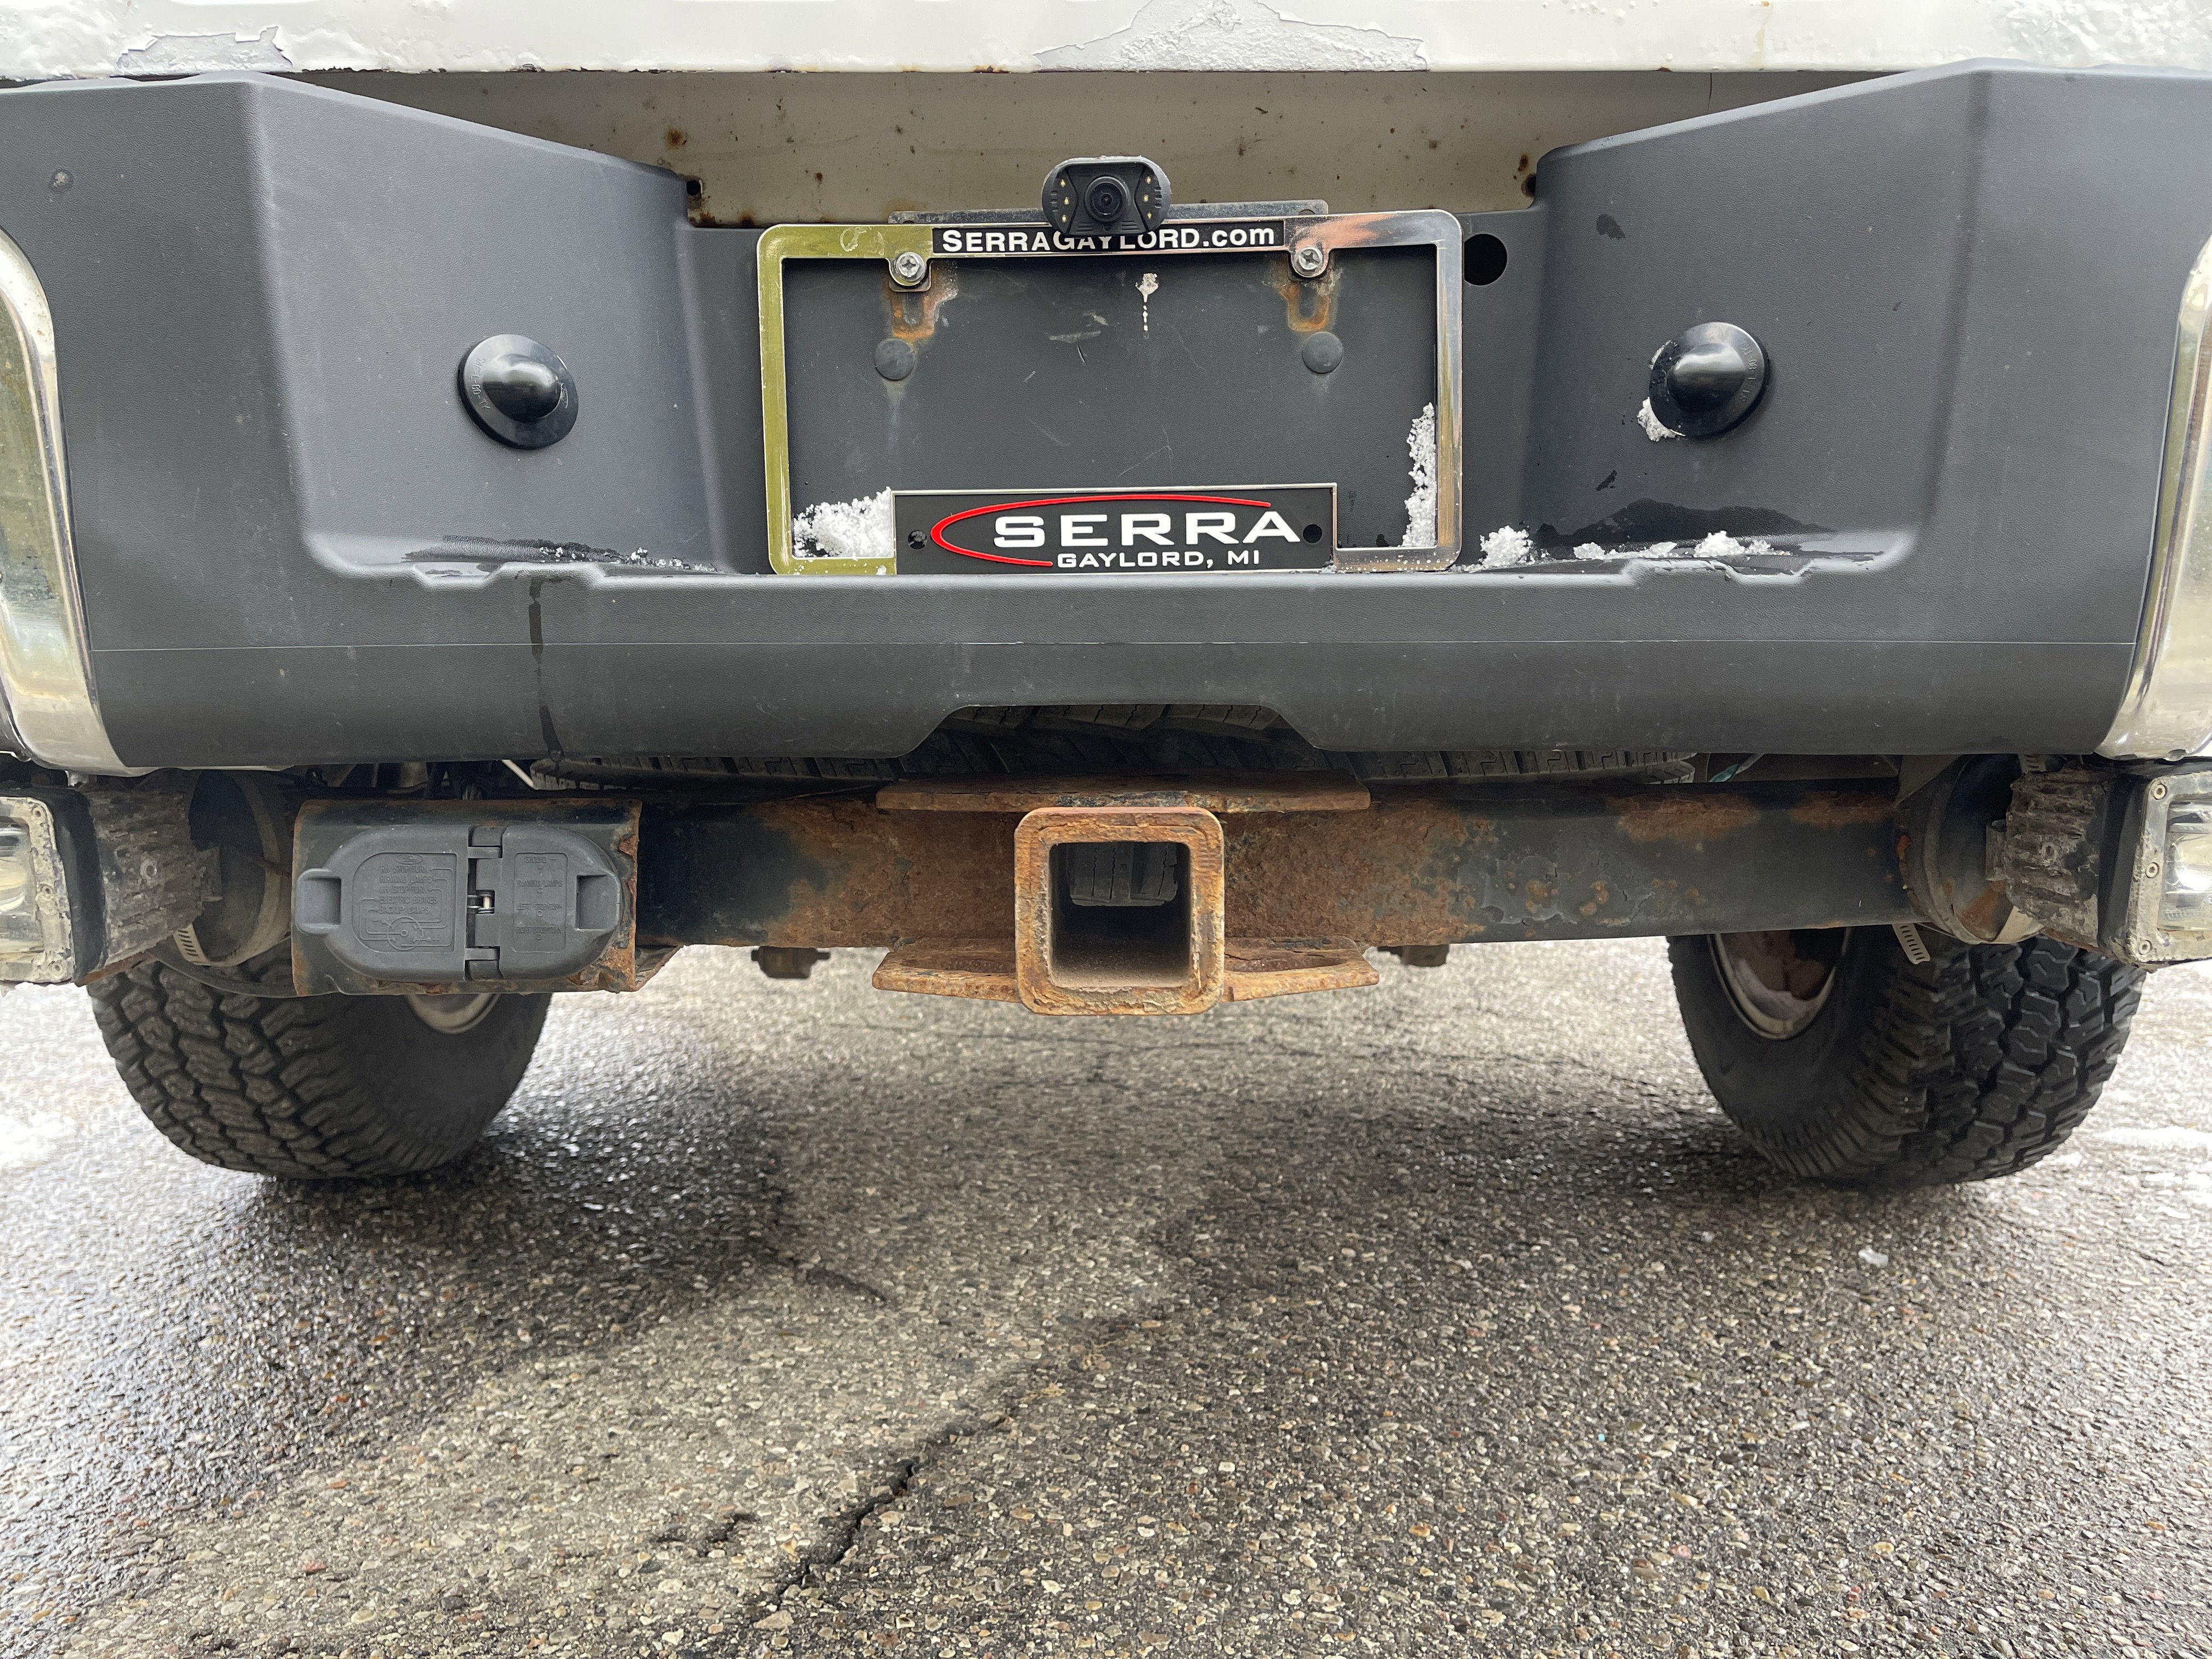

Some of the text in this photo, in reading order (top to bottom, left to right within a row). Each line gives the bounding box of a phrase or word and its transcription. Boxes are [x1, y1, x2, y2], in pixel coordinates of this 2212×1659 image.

[942, 228, 1274, 252] SERRAGAYLORD.com
[994, 511, 1300, 548] SERRA
[1057, 550, 1260, 568] GAYLORD, MI
